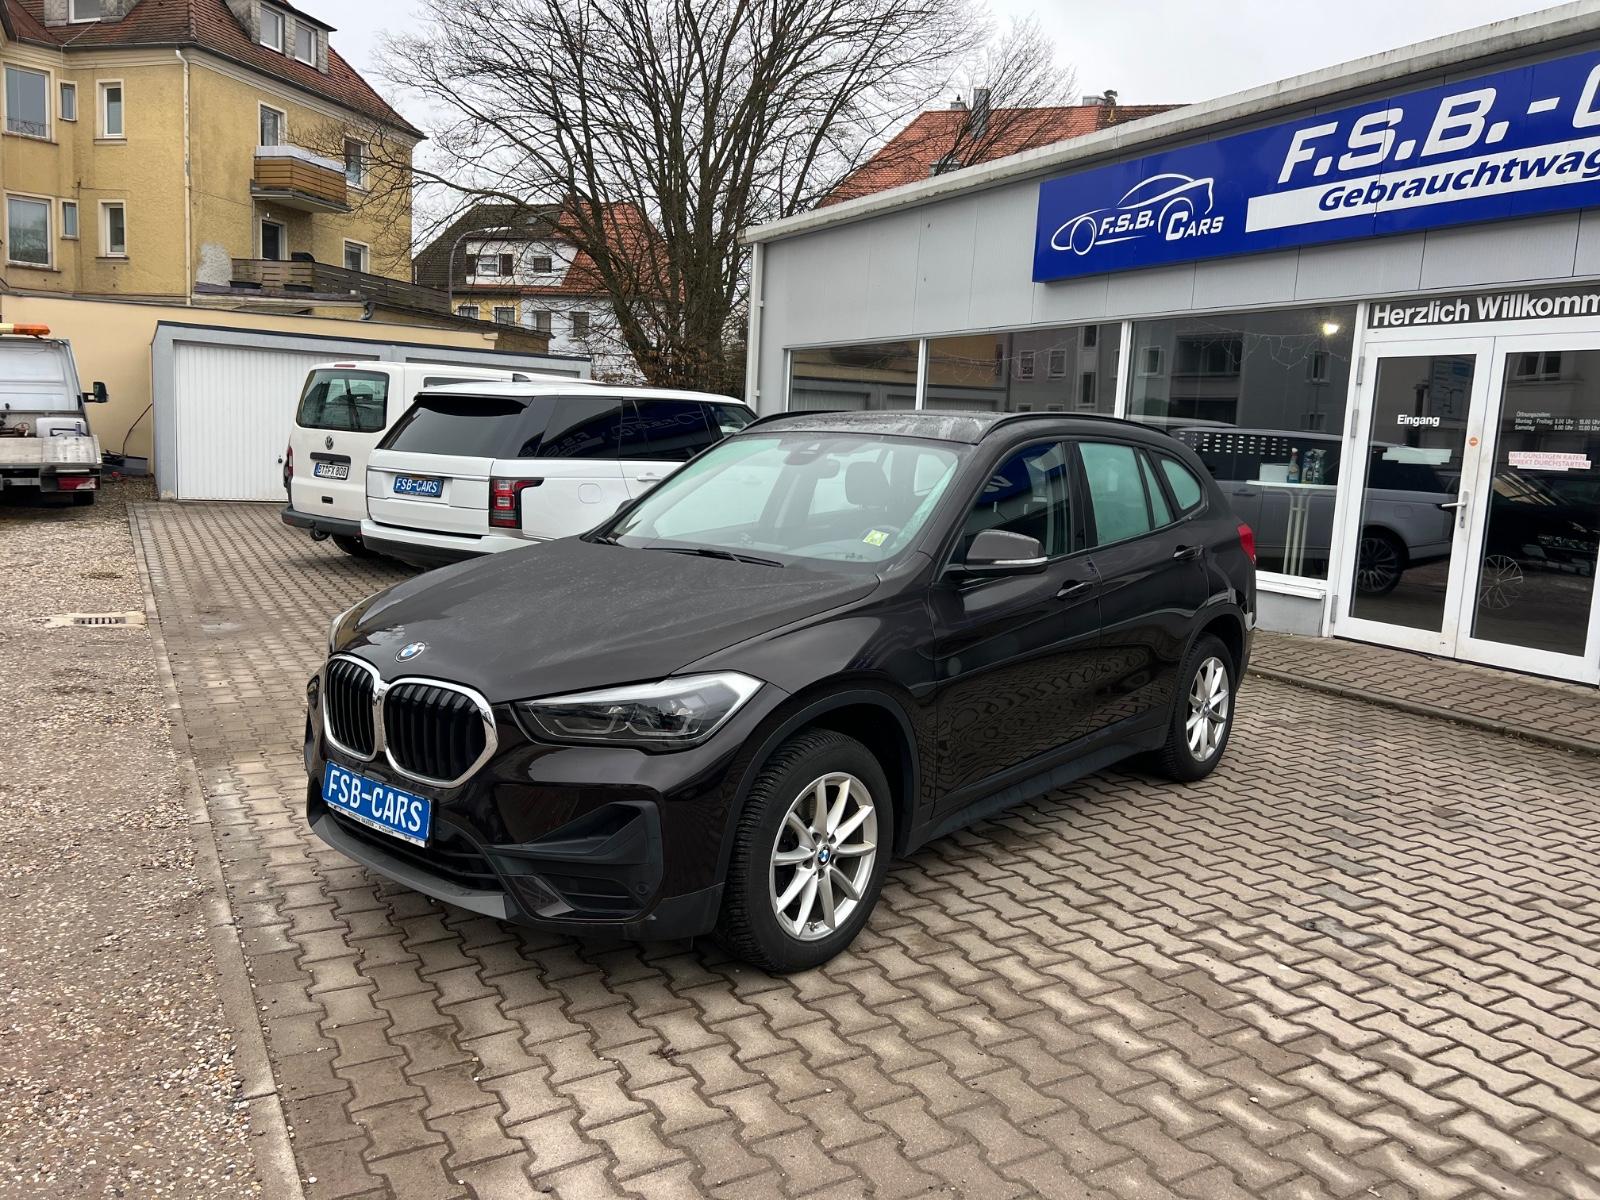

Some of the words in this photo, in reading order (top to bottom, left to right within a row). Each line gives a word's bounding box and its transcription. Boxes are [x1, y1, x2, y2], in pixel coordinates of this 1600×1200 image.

[1277, 87, 1509, 184] F.S.B.
[1098, 210, 1155, 236] F.S.B.
[1165, 210, 1225, 242] CARS
[1372, 299, 1470, 326] Herzlich
[1397, 414, 1440, 427] Eingang
[395, 478, 438, 493] FSB-CARS
[328, 769, 423, 832] FSB-CARS
